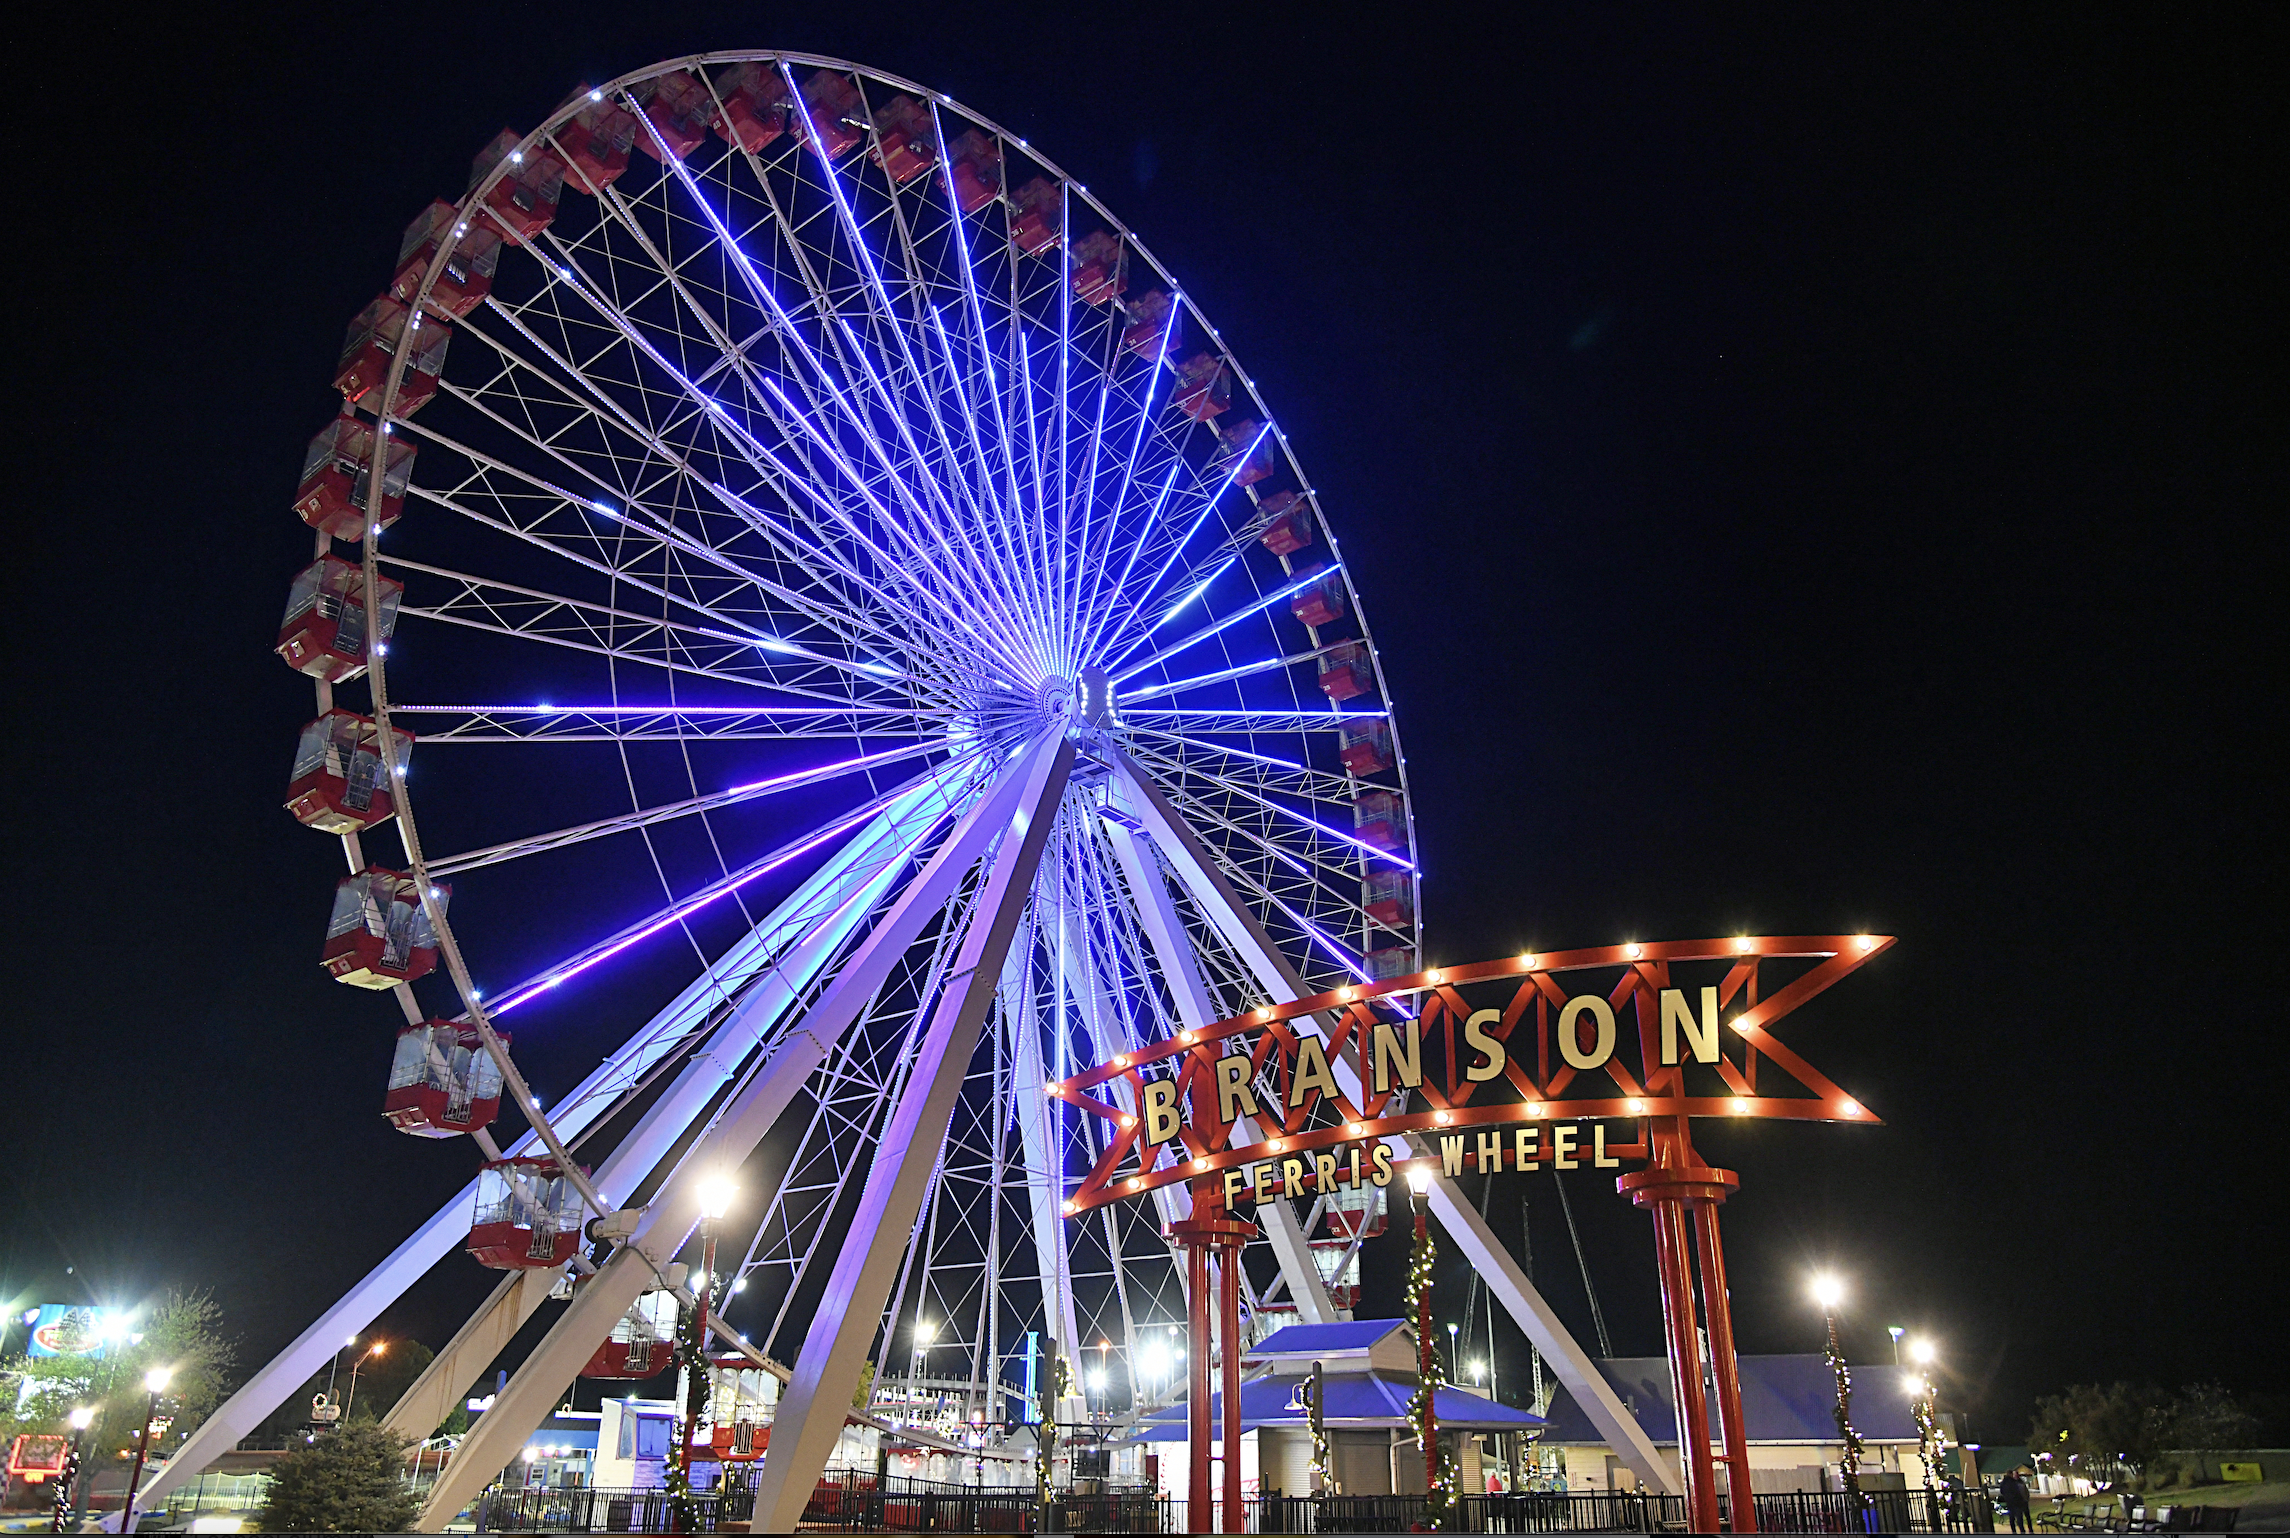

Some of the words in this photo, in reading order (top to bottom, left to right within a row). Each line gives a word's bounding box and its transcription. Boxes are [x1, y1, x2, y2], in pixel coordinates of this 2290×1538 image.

[1143, 985, 1721, 1146] BRANSON
[1224, 1144, 1394, 1210] FERRIS
[1439, 1124, 1620, 1178] WHEEL
[24, 1472, 45, 1483] OPEN
